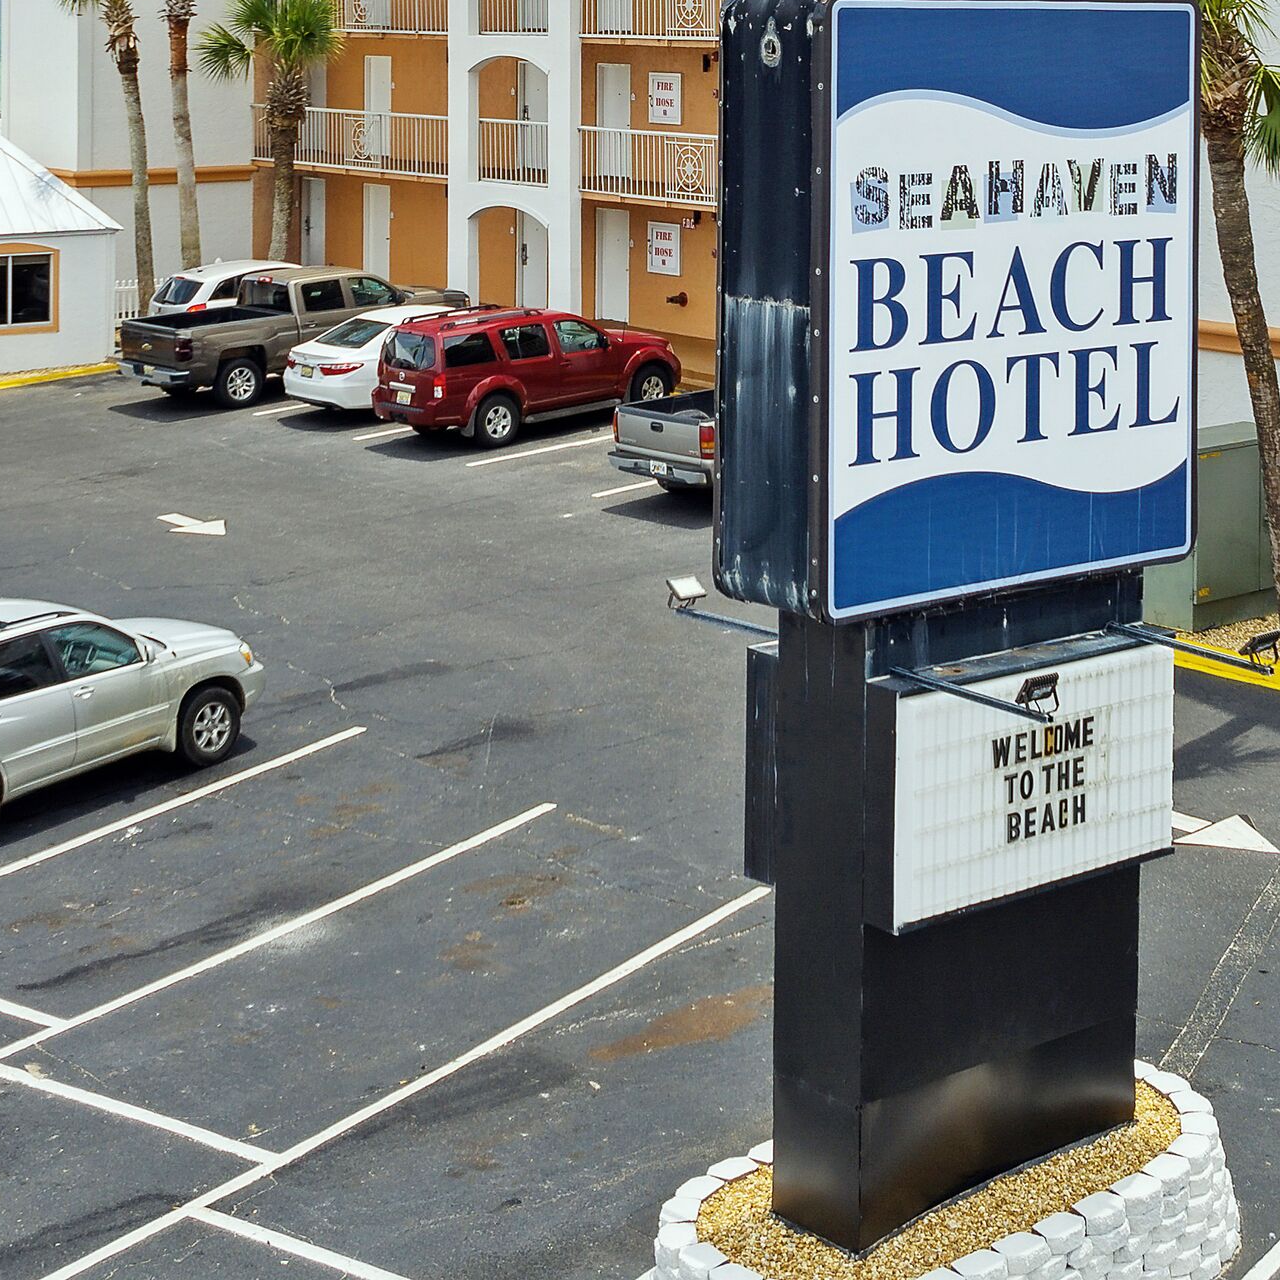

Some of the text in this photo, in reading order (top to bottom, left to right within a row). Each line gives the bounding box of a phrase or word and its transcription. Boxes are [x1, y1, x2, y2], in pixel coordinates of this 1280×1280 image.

[655, 97, 675, 108] HOSE
[656, 81, 674, 91] FIRE
[854, 152, 1178, 231] SEAHAVEN
[654, 247, 674, 258] HOSE
[655, 231, 673, 241] FIRE
[848, 236, 1174, 354] BEACH
[848, 340, 1181, 468] HOTEL
[991, 715, 1095, 770] WELCOME
[1004, 755, 1085, 805] TO THE
[1006, 793, 1086, 844] BEACH
